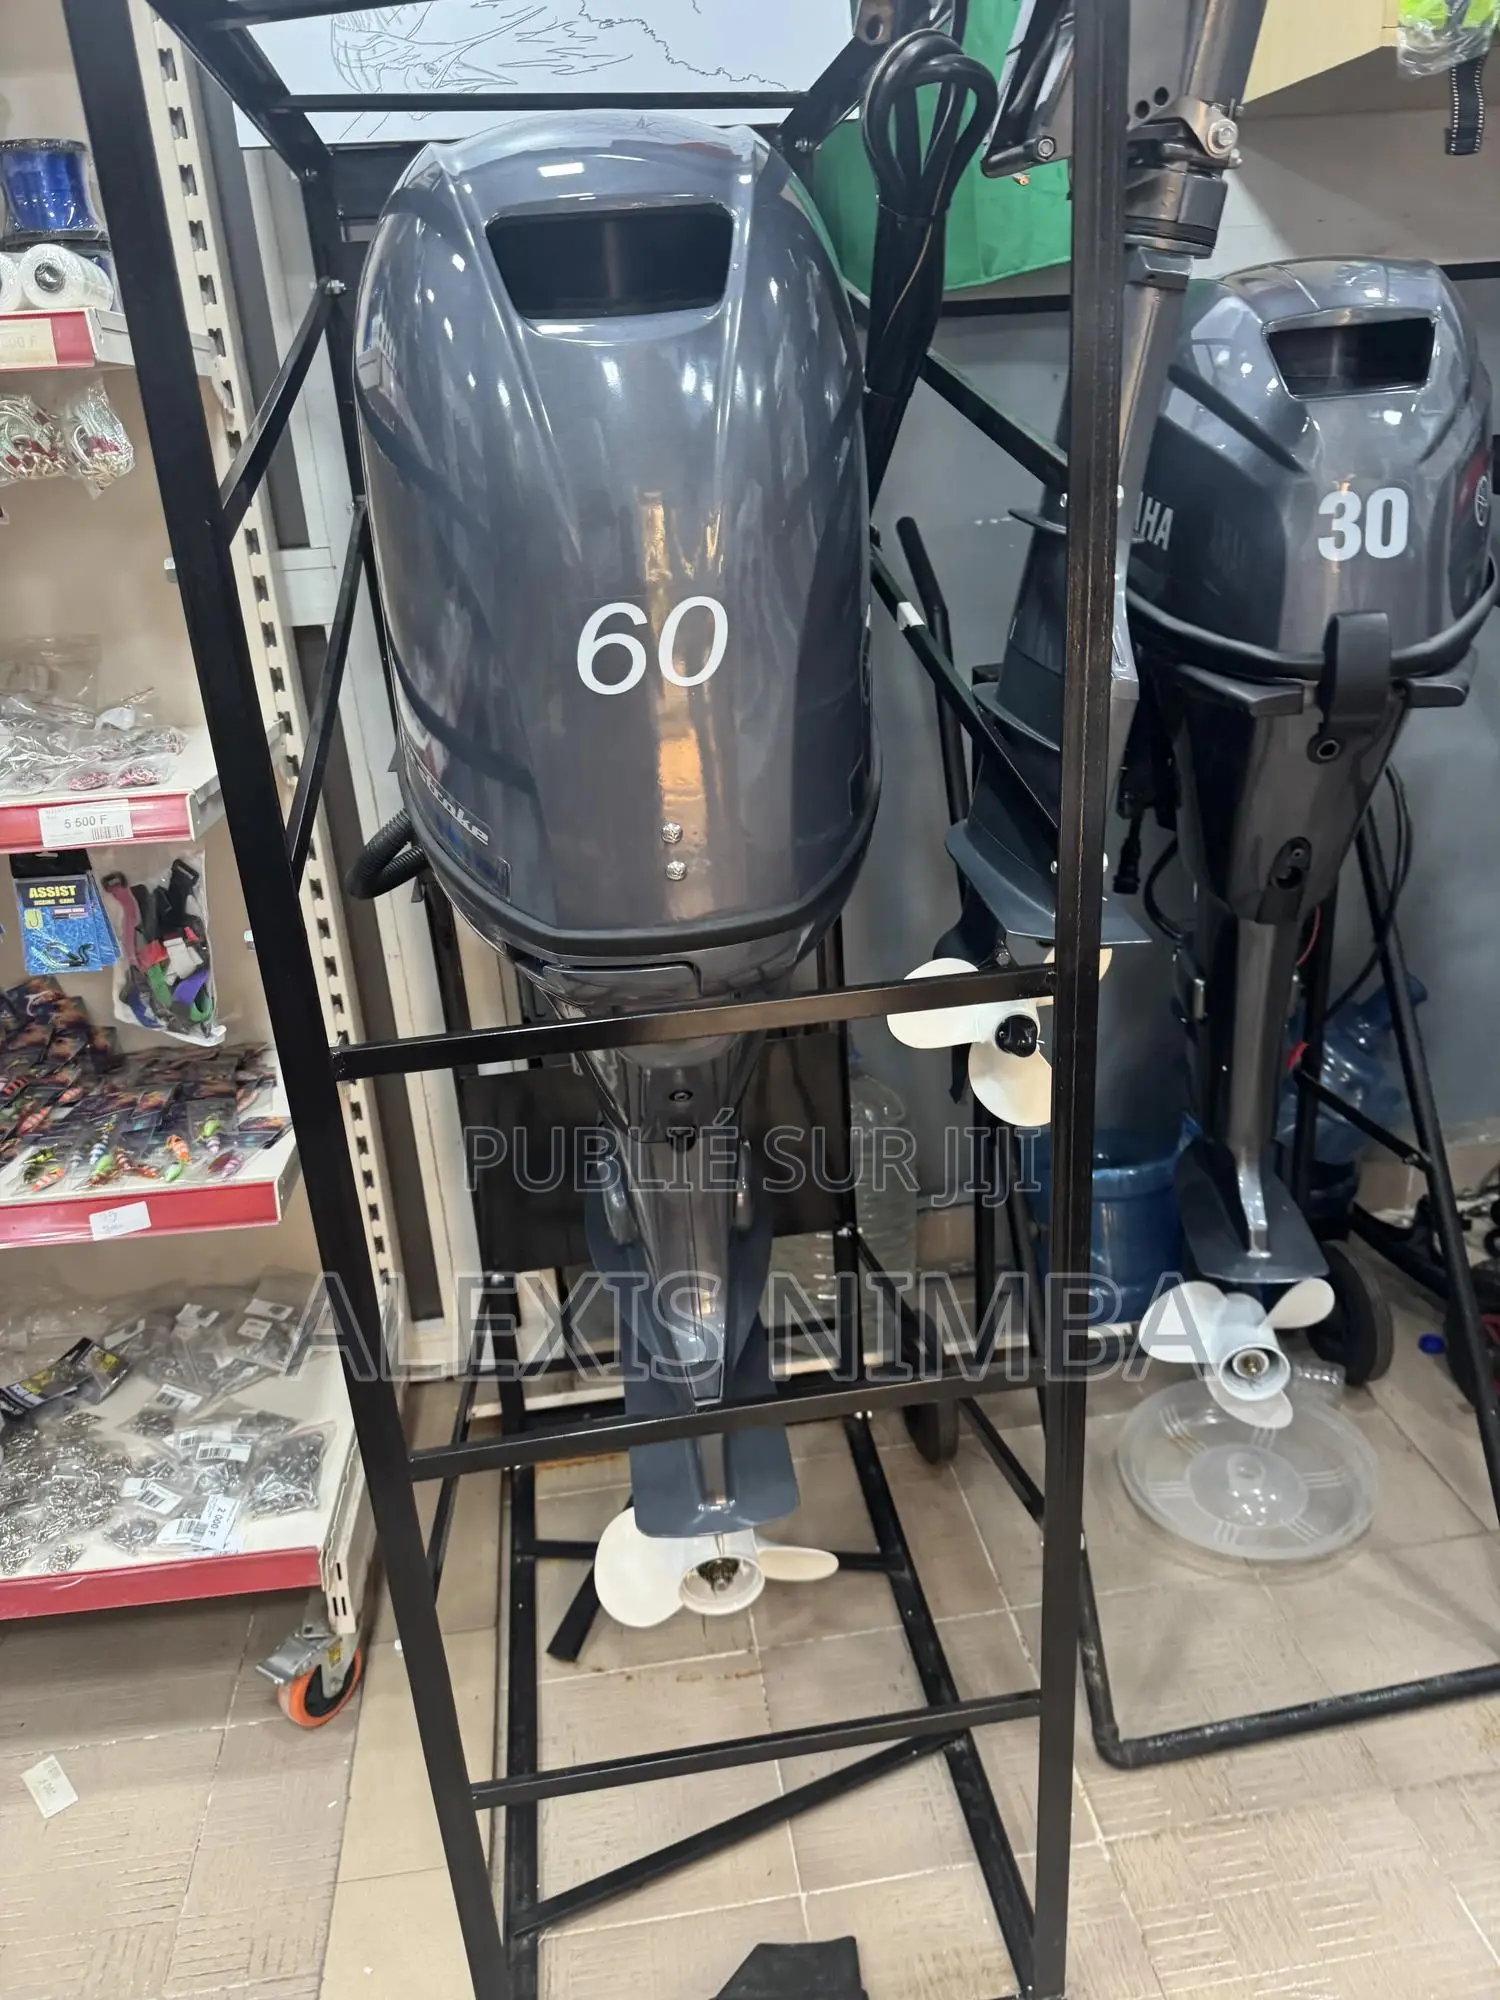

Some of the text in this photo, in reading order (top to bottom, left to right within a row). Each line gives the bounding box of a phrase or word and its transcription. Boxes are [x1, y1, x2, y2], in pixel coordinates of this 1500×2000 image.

[1318, 487, 1409, 561] 30
[577, 596, 729, 695] 60
[64, 814, 108, 829] 5 500 F
[29, 885, 76, 898] ASSIST
[210, 1514, 223, 1529] 000
